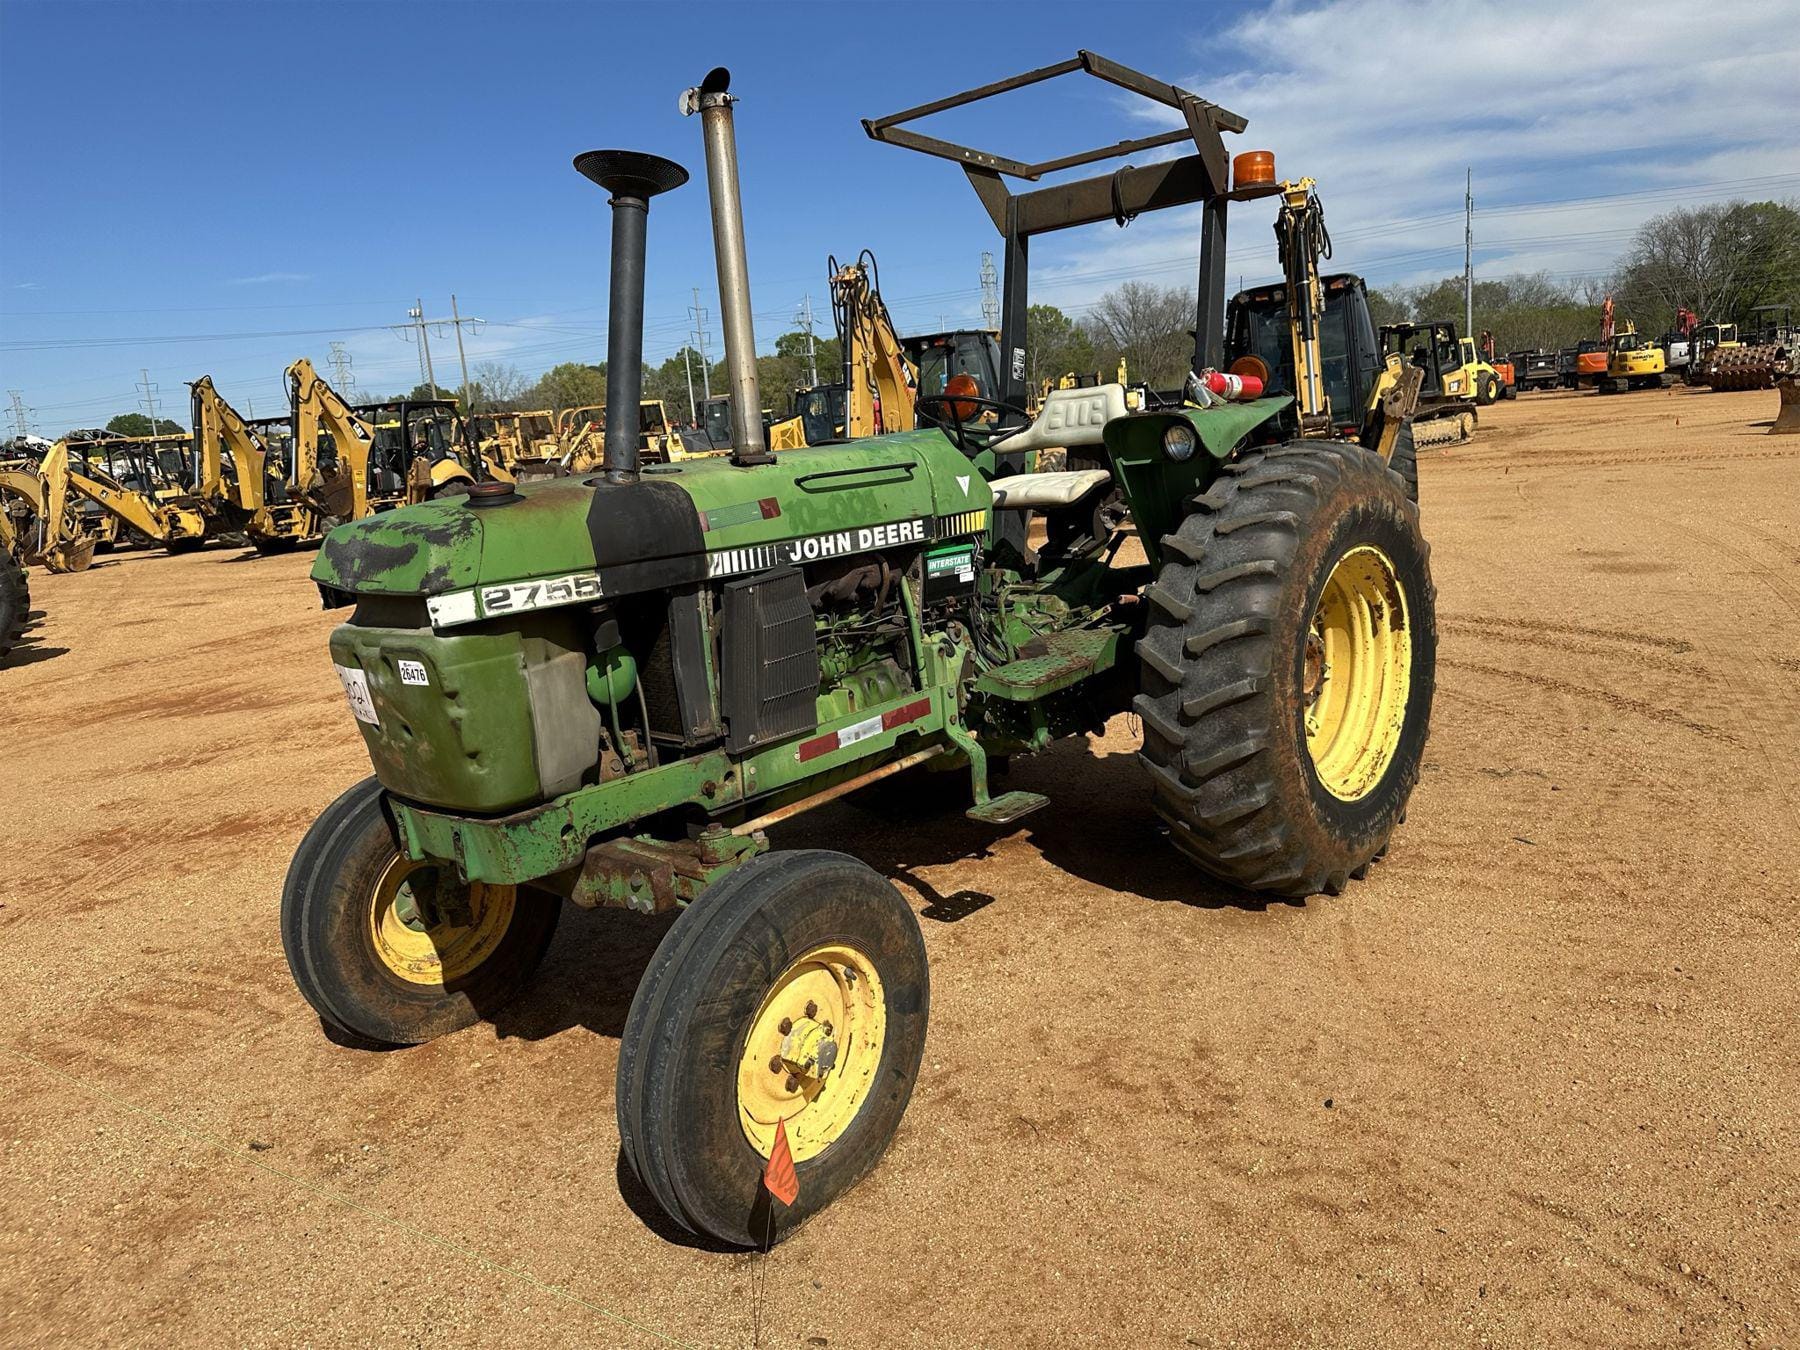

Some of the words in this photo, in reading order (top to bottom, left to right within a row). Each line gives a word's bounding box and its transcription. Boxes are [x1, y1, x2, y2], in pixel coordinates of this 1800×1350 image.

[352, 422, 365, 438] CAT
[26, 463, 38, 476] CAT
[788, 532, 851, 562] JOHN
[858, 519, 925, 550] DEERE
[929, 556, 969, 570] INTERSTATE
[484, 574, 601, 612] 2755
[401, 667, 426, 682] 26476
